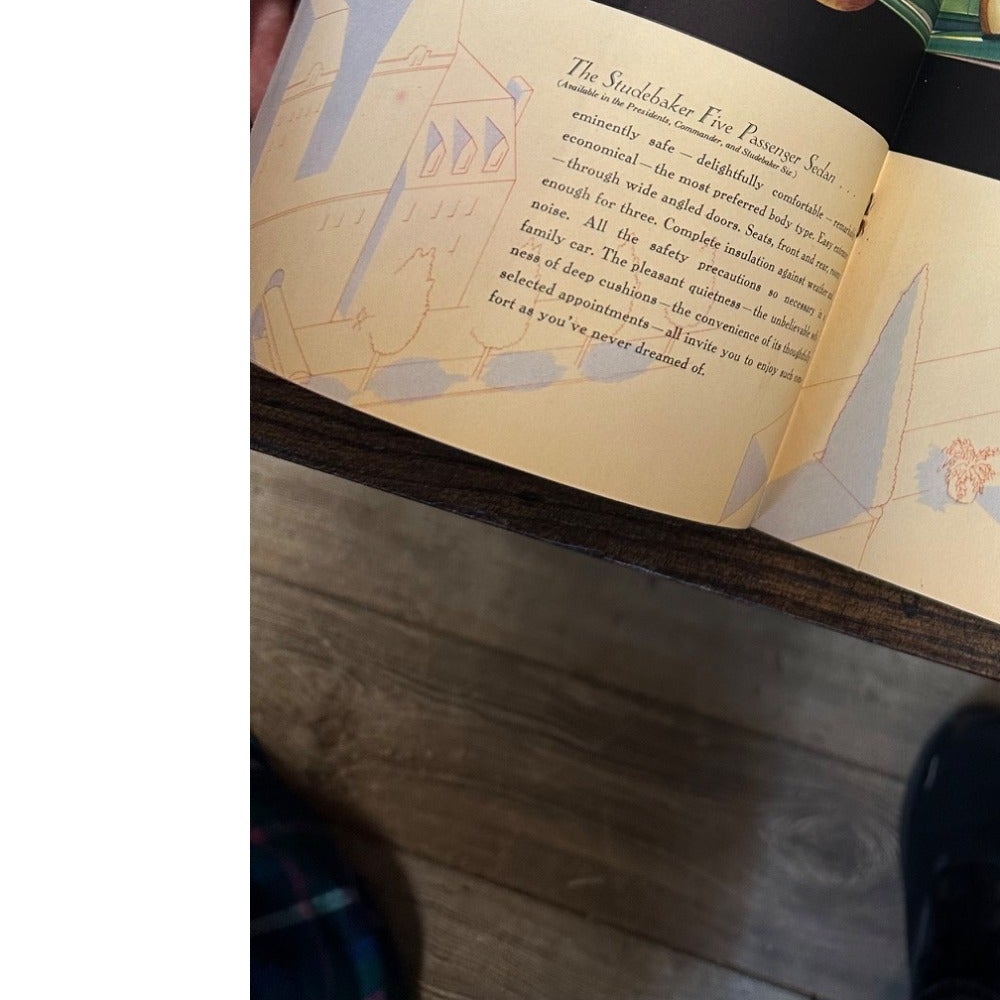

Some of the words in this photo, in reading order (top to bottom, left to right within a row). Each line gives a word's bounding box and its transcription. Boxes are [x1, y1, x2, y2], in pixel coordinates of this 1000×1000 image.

[557, 79, 600, 99] (Available
[600, 93, 611, 103] in
[611, 96, 625, 108] the
[626, 101, 672, 126] Presidents,
[674, 120, 723, 147] Commander,
[724, 142, 741, 154] and
[741, 147, 782, 171] Studebaker
[567, 56, 599, 84] The
[602, 69, 695, 118] Studebaker
[698, 105, 734, 134] Five
[737, 121, 802, 165] Passenger
[803, 153, 836, 184] Sedan
[572, 111, 641, 141] eminently
[649, 137, 676, 154] safe
[696, 153, 765, 191] delightfully
[772, 188, 824, 220] comfortable
[530, 199, 570, 221] noise.
[583, 215, 609, 233] All
[617, 227, 640, 245] the
[649, 243, 689, 264] safety
[697, 260, 762, 293] precautions
[768, 288, 779, 299] so
[783, 295, 816, 317] necessary
[541, 177, 591, 201] enough
[595, 192, 617, 210] for
[619, 202, 658, 226] three.
[663, 216, 722, 250] Complete
[723, 242, 776, 273] insulation
[777, 266, 806, 287] against
[626, 180, 658, 199] wide
[661, 193, 705, 217] angled
[706, 208, 741, 233] doors.
[745, 223, 774, 248] Seats,
[777, 238, 801, 259] front
[800, 253, 817, 266] and
[815, 260, 829, 274] rear,
[678, 174, 711, 195] most
[712, 189, 767, 217] preferred
[768, 208, 793, 229] body
[794, 223, 815, 240] type.
[816, 231, 834, 251] Easy
[499, 270, 557, 296] selected
[683, 331, 718, 354] invite
[720, 348, 742, 363] you
[744, 354, 754, 368] to
[756, 361, 780, 378] enjoy
[509, 246, 542, 264] ness
[544, 256, 563, 271] of
[562, 262, 595, 283] deep
[695, 312, 760, 343] convenience
[761, 334, 774, 347] of
[771, 337, 783, 352] its
[520, 218, 567, 246] family
[569, 240, 595, 256] car.
[601, 245, 629, 268] The
[630, 260, 686, 289] pleasant
[770, 313, 811, 338] unbelievable
[487, 289, 516, 311] fort
[518, 302, 535, 317] as
[537, 310, 588, 336] you've
[591, 329, 633, 351] never
[636, 341, 691, 370] dreamed
[691, 362, 706, 377] of.
